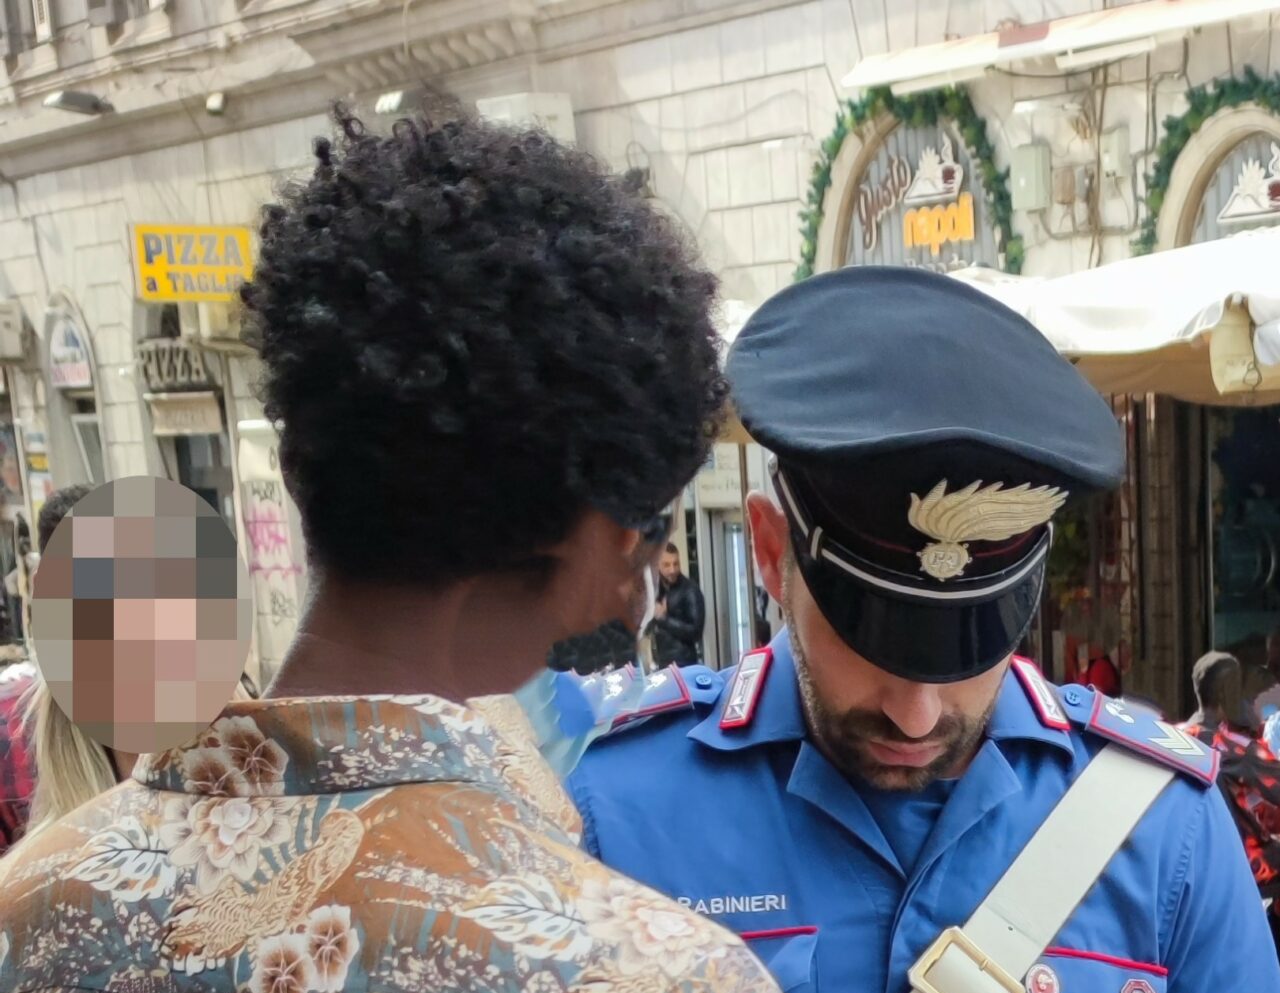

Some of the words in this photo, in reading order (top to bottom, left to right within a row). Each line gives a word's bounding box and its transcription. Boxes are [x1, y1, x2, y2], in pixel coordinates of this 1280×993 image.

[903, 191, 976, 257] napoli
[143, 233, 243, 267] PIZZA
[145, 276, 158, 293] a
[138, 345, 208, 389] PIZZA
[677, 894, 786, 914] RABINIERI
